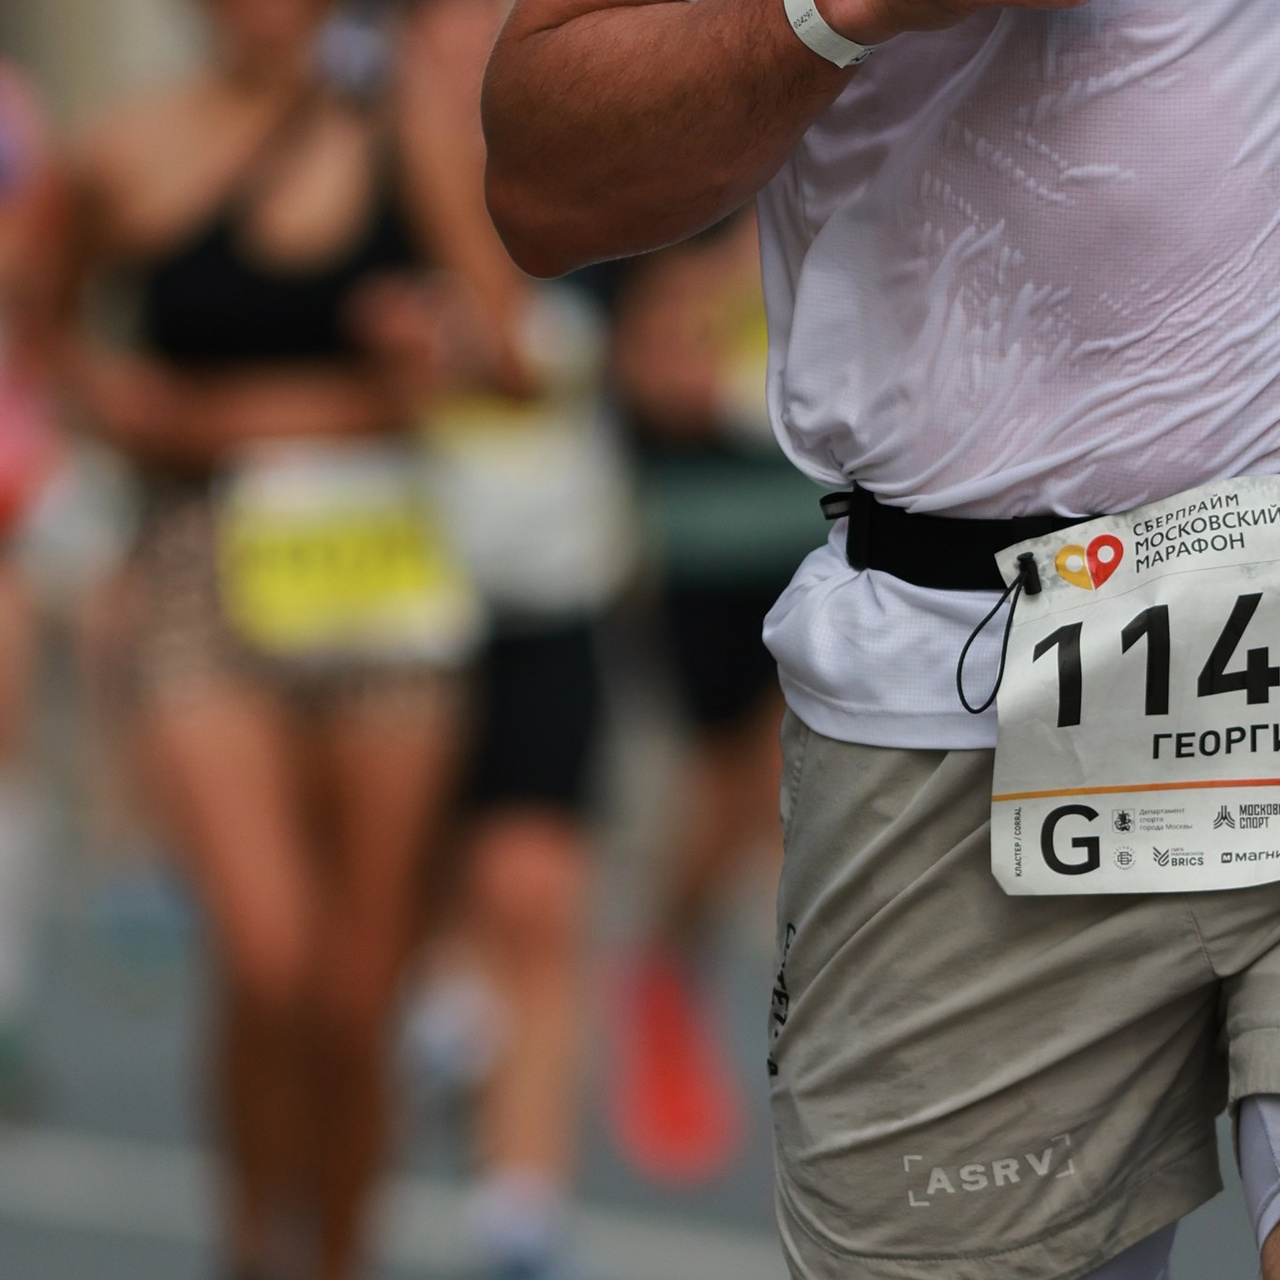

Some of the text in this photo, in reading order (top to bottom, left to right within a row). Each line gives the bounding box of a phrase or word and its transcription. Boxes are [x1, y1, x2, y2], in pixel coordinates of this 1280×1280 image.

[1133, 494, 1239, 536] СБЕРПРАЙМ
[1136, 532, 1245, 573] МАРАФОН
[1014, 806, 1022, 836] CORRAL
[1139, 808, 1185, 816] Департамент
[1239, 816, 1270, 829] СПОРТ
[1040, 804, 1101, 876] G
[1014, 842, 1022, 877] КЛАСТЕР
[1171, 856, 1204, 867] BRICS
[927, 1148, 1053, 1195] ASRV
